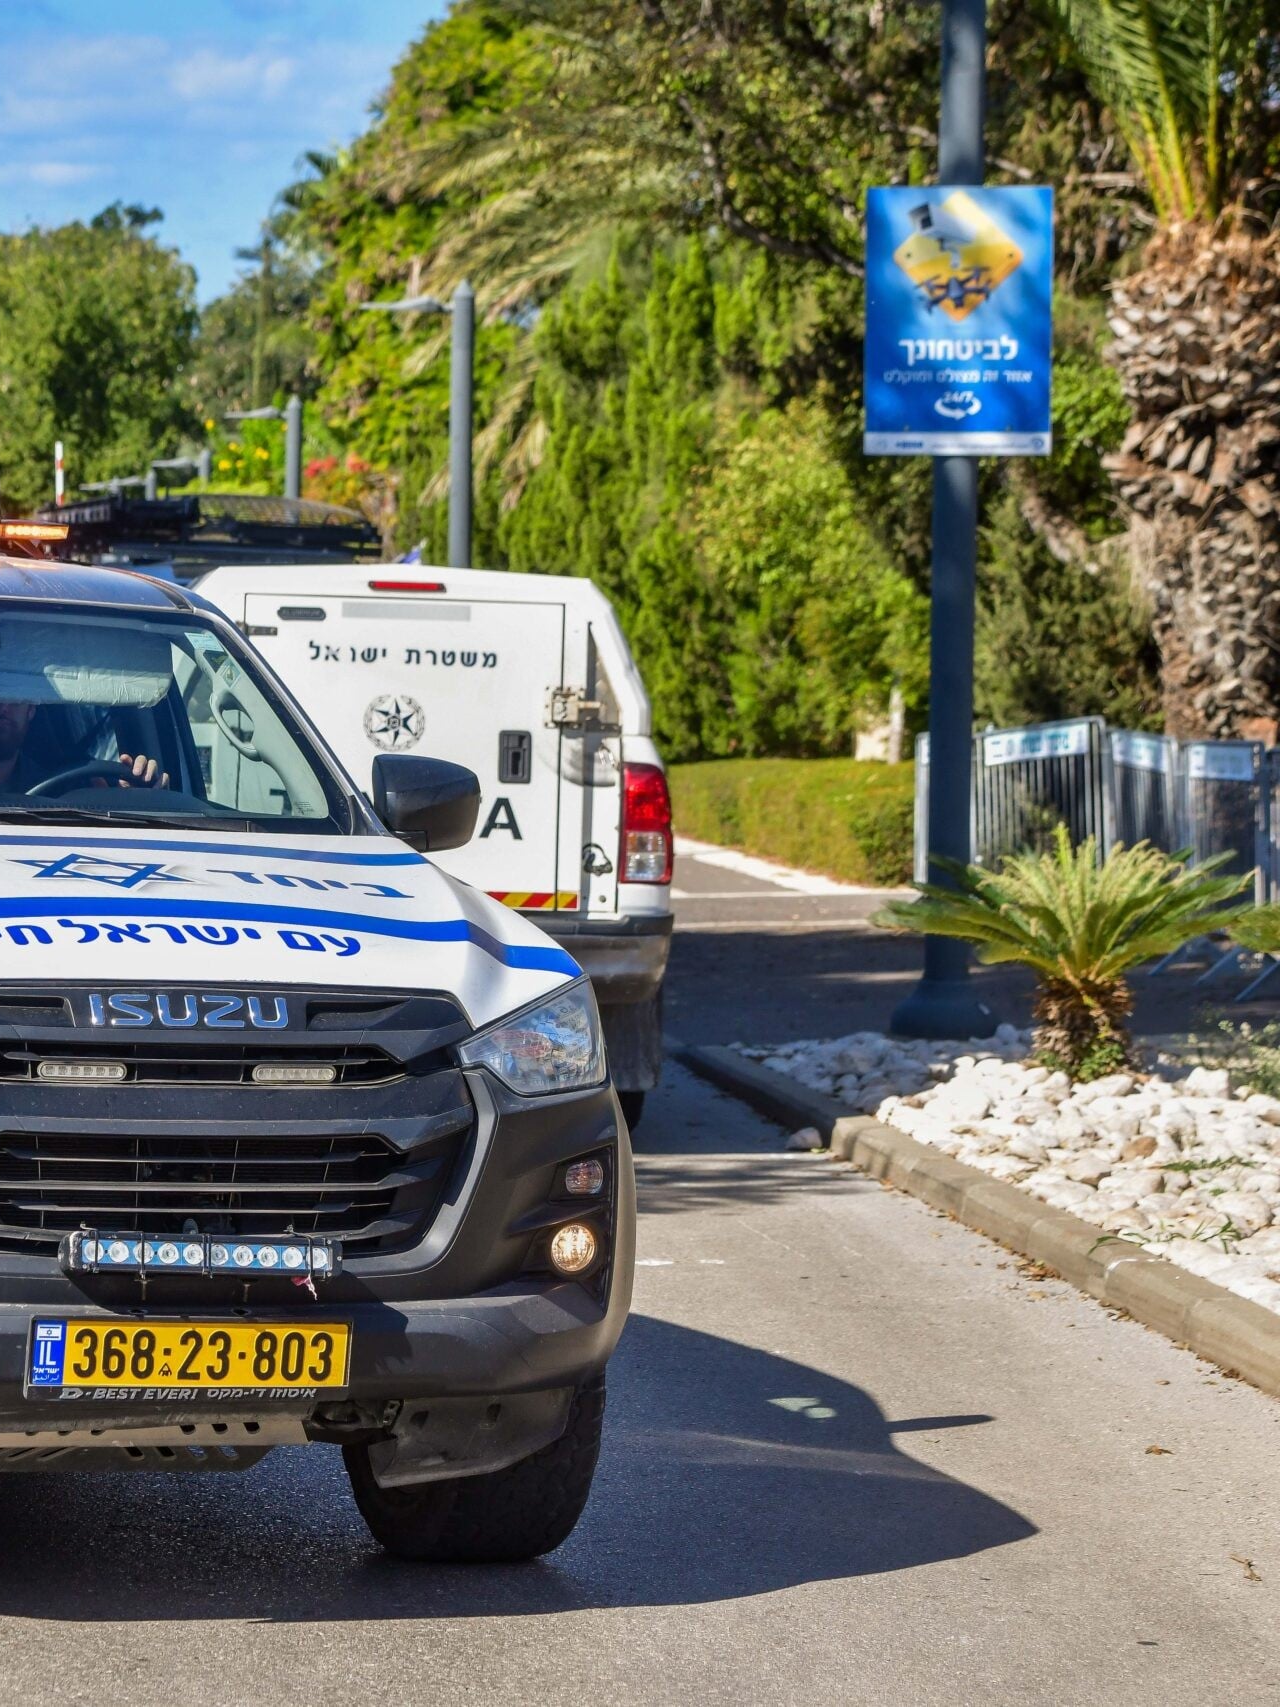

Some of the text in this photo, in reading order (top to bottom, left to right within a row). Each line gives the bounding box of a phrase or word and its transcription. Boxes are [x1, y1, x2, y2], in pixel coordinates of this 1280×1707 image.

[898, 334, 1019, 367] לביטחונך
[309, 639, 498, 668] משטרת ישראל
[479, 797, 523, 840] A
[206, 868, 416, 899] ביחד
[57, 918, 261, 946] ישראל
[277, 930, 361, 957] עם
[88, 992, 289, 1029] ISUZU
[38, 1341, 57, 1365] IL
[33, 1366, 60, 1374] ישראל
[144, 1388, 197, 1400] EVER!
[206, 1388, 317, 1400] איסוזו די-מקס
